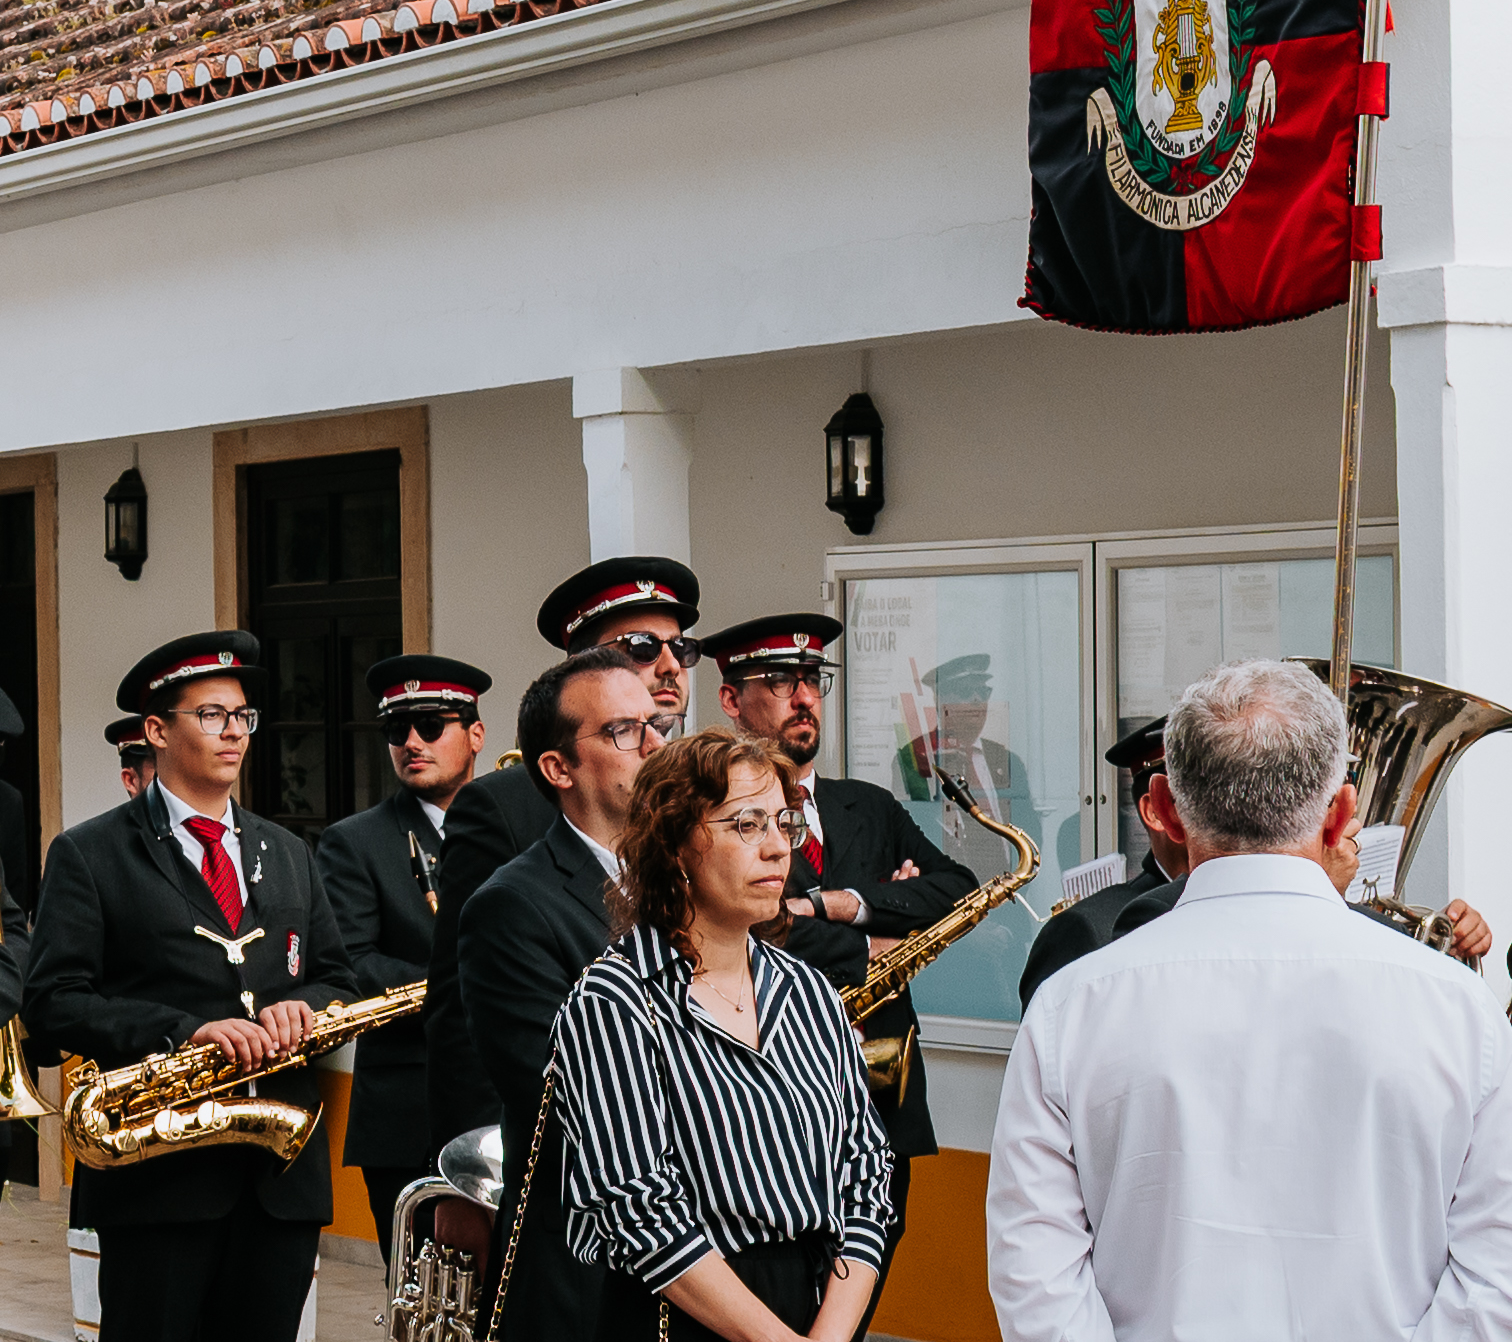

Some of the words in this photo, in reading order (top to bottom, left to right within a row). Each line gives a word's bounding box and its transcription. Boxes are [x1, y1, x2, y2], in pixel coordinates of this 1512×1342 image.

[1145, 118, 1185, 156] FUNDADA
[1189, 132, 1206, 153] EM
[1207, 100, 1227, 135] 1898
[1107, 144, 1181, 226] FILARMÓNICA
[1187, 125, 1257, 224] ALCANEDENSE
[854, 631, 897, 653] VOTAR
